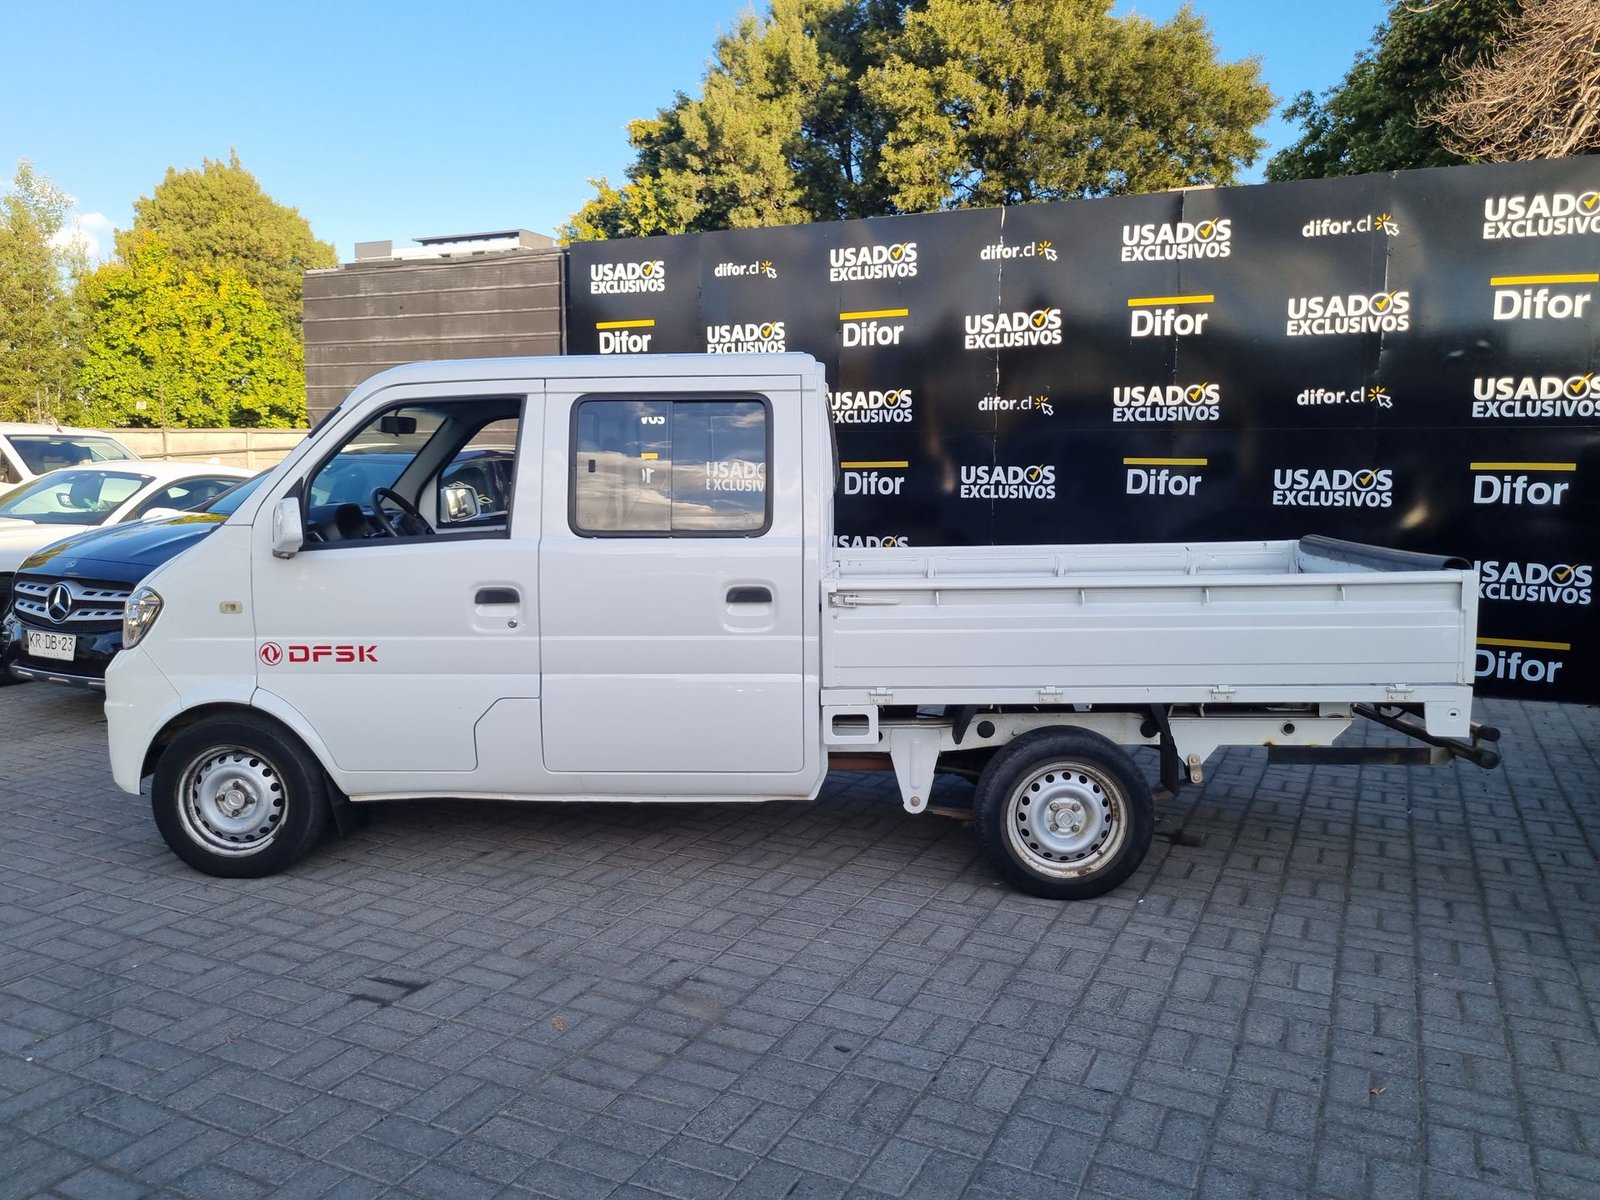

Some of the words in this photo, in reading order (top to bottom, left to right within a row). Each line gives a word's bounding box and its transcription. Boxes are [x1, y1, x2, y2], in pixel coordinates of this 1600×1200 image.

[1484, 192, 1600, 221] USADO
[1122, 219, 1232, 246] USADOS
[1302, 214, 1371, 238] difor.cl
[830, 243, 917, 267] USADOS
[980, 241, 1035, 260] difor.cl
[1121, 241, 1231, 262] EXCLUSIVOS
[591, 260, 665, 281] USADOS
[714, 261, 759, 278] difor.cl
[829, 262, 917, 282] EXCLUSIVOS
[591, 279, 665, 294] EXCLUSIVOS
[1288, 291, 1410, 319] USADOS
[1493, 288, 1591, 320] Difor
[706, 321, 785, 343] USADOS
[965, 308, 1062, 335] USADOS
[1130, 308, 1208, 337] Difor
[1286, 314, 1410, 336] EXCLUSIVOS
[599, 330, 652, 354] Difor
[843, 321, 904, 347] Difor
[964, 329, 1062, 350] EXCLUSIVOS
[706, 340, 786, 354] EXCLUSIVOS
[1113, 383, 1220, 407] USADOS
[1296, 386, 1364, 406] difor.cl
[1473, 376, 1600, 400] USADOS
[828, 389, 912, 410] USADOS
[978, 395, 1032, 412] difor.cl
[1112, 405, 1220, 422] EXCLUSIVOS
[844, 471, 904, 495] Difor
[960, 465, 1055, 486] USADOS
[1126, 468, 1201, 496] Difor
[1273, 468, 1392, 491] USADOS
[960, 484, 1056, 499] EXCLUSIVOS
[1272, 490, 1392, 508] EXCLUSIVOS
[1473, 475, 1569, 505] Difor
[1478, 583, 1592, 605] XCLUSIVOS
[289, 645, 378, 662] DFSK
[1475, 649, 1563, 683] Difor
